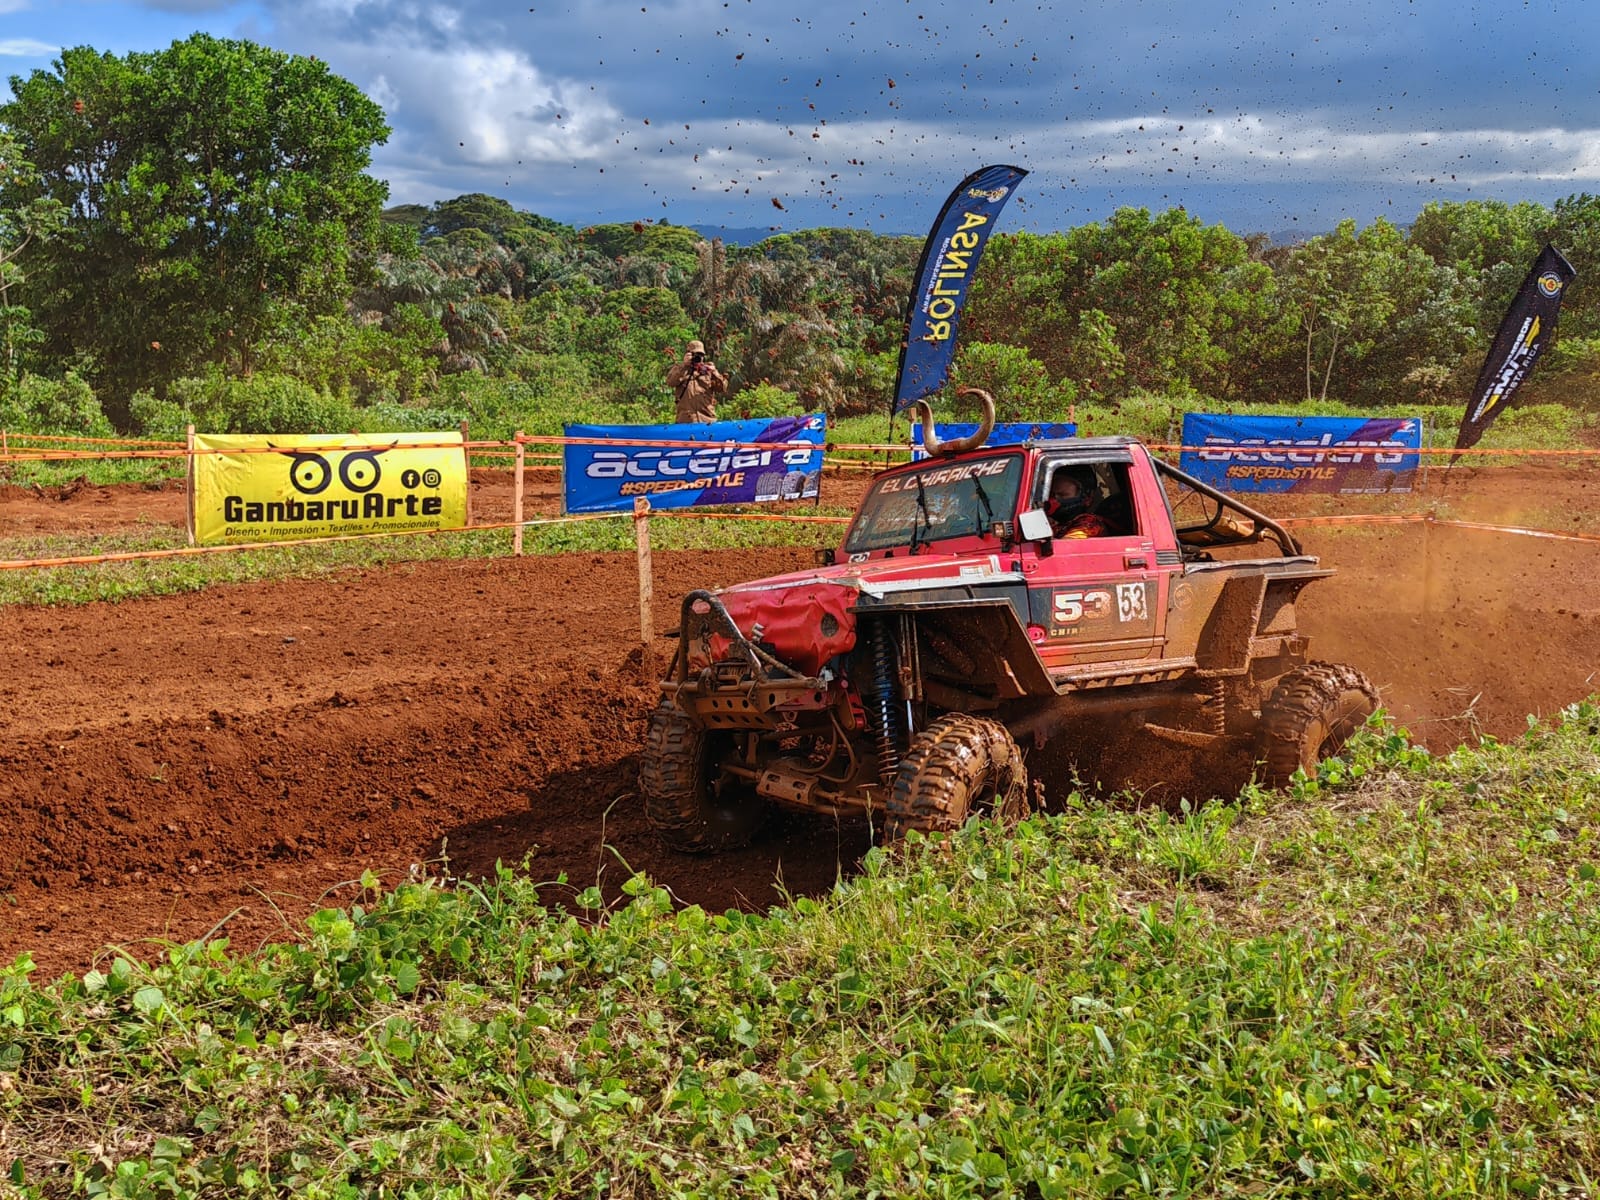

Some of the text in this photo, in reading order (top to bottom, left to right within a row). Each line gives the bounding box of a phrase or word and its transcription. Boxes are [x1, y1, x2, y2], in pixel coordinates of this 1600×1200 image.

[1522, 343, 1540, 368] RICA
[586, 440, 813, 478] accelera
[1197, 433, 1406, 463] accelera
[879, 478, 901, 494] EL
[225, 519, 441, 537] Diseño Impresión Textiles Promocionales
[1053, 590, 1113, 624] 53
[1120, 585, 1144, 617] 53
